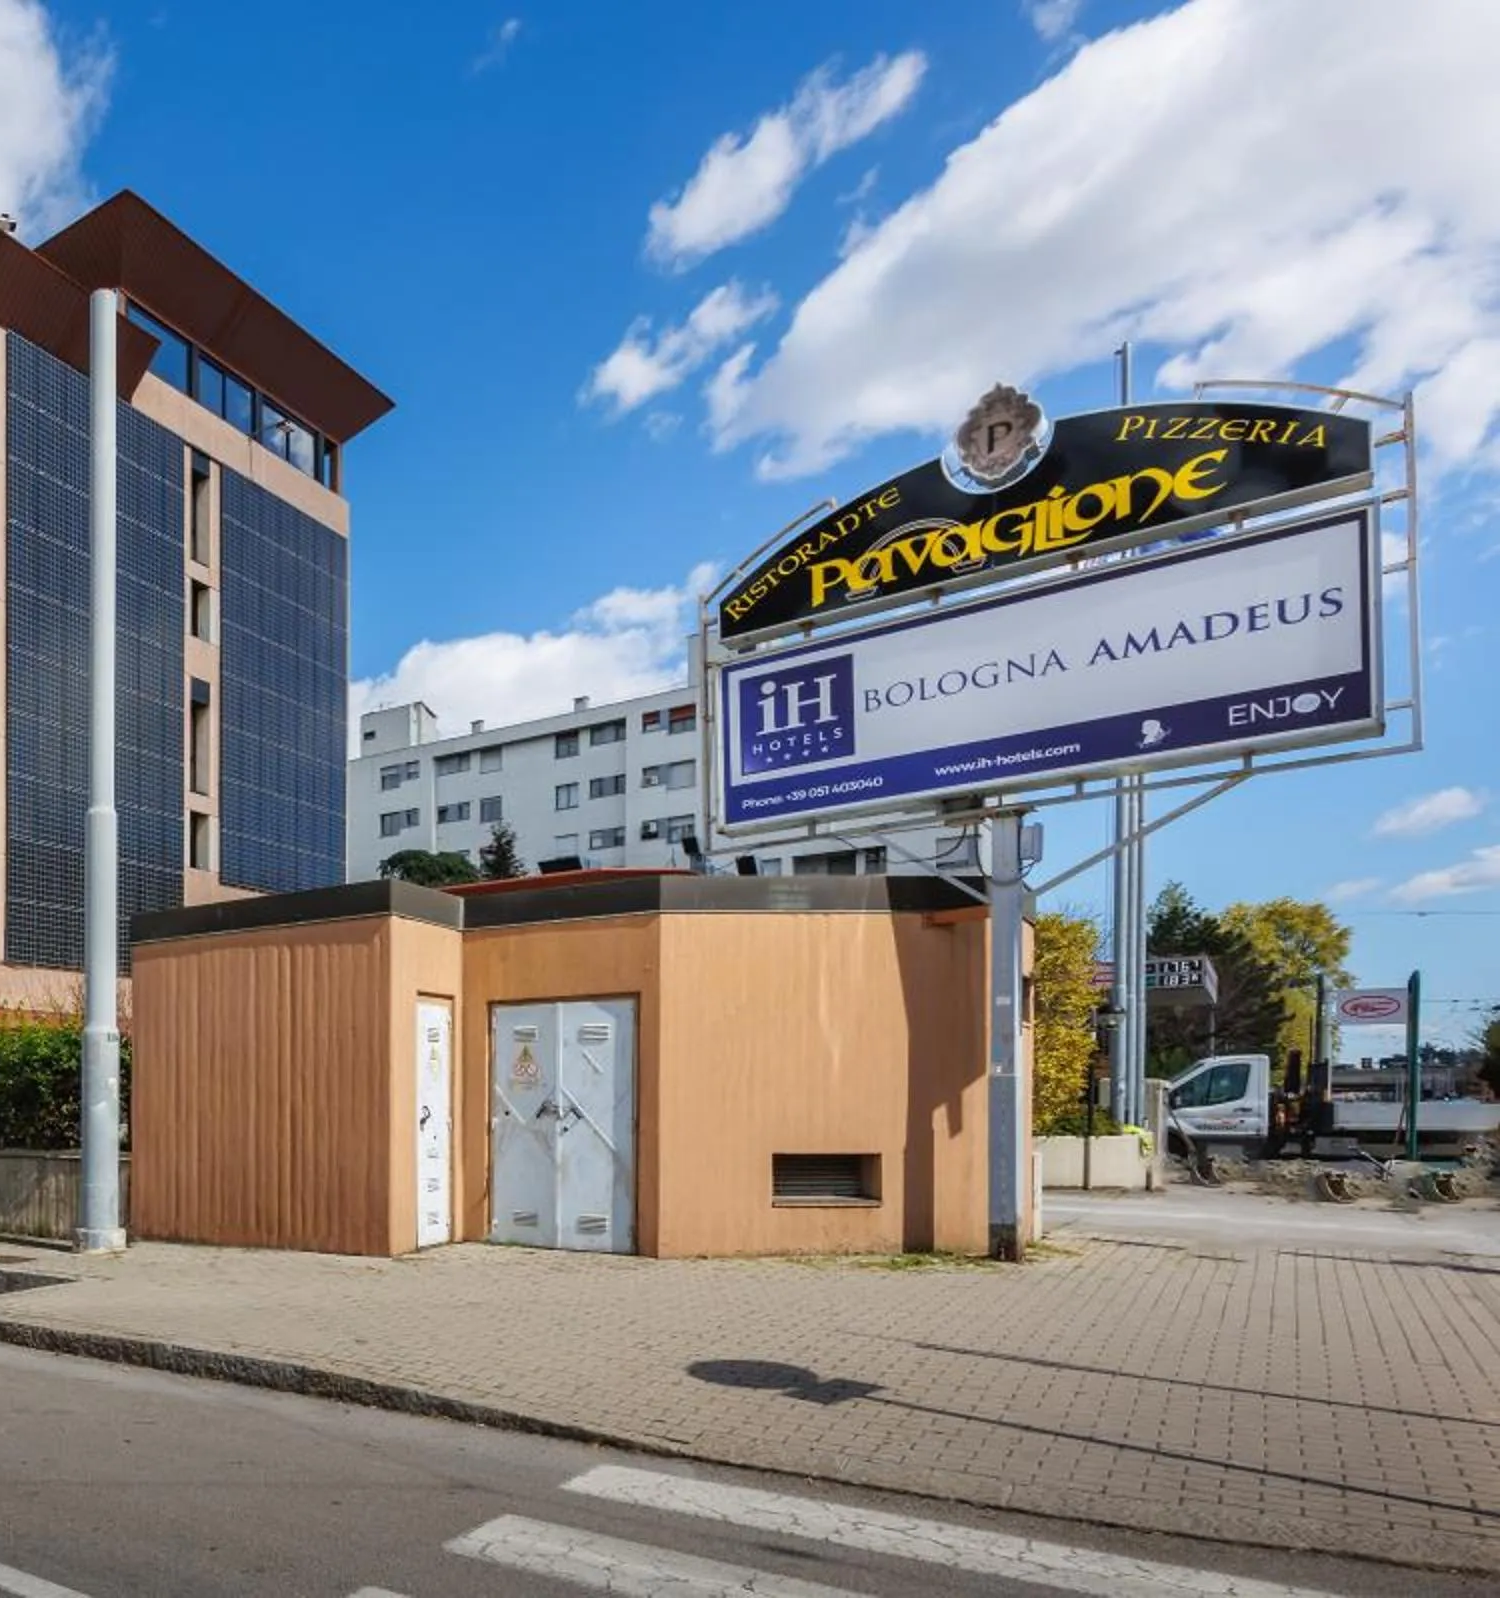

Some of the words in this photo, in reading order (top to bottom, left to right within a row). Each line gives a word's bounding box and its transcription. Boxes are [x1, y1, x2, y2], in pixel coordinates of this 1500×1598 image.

[987, 421, 1012, 454] P
[1115, 415, 1326, 449] PIZZERIA
[864, 649, 1070, 713] BOLOGNA
[1088, 587, 1345, 666] AMADEUS
[1228, 687, 1345, 727] ENJOY
[752, 727, 843, 756] HOTELS
[934, 743, 1081, 777] www.ih-hotels.com
[808, 785, 830, 799] 051
